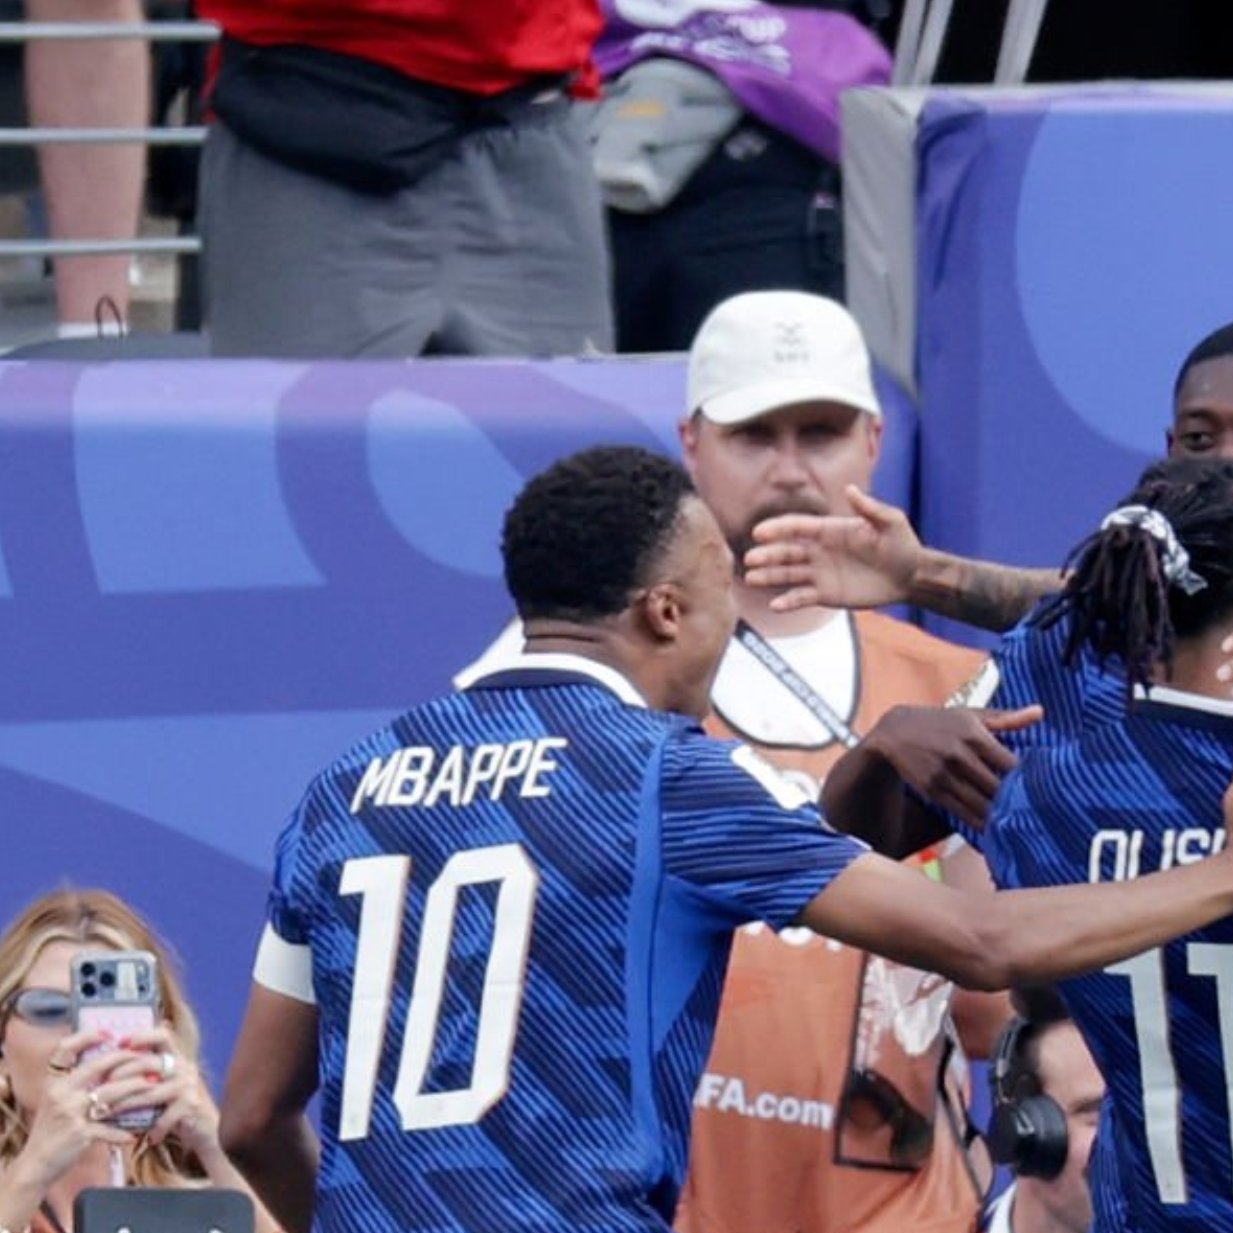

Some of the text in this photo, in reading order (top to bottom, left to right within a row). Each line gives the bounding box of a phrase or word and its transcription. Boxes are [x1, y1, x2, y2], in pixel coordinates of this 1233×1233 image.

[350, 736, 568, 815] MBAPPE
[338, 842, 541, 1142] 10
[694, 1073, 834, 1130] FA.com
